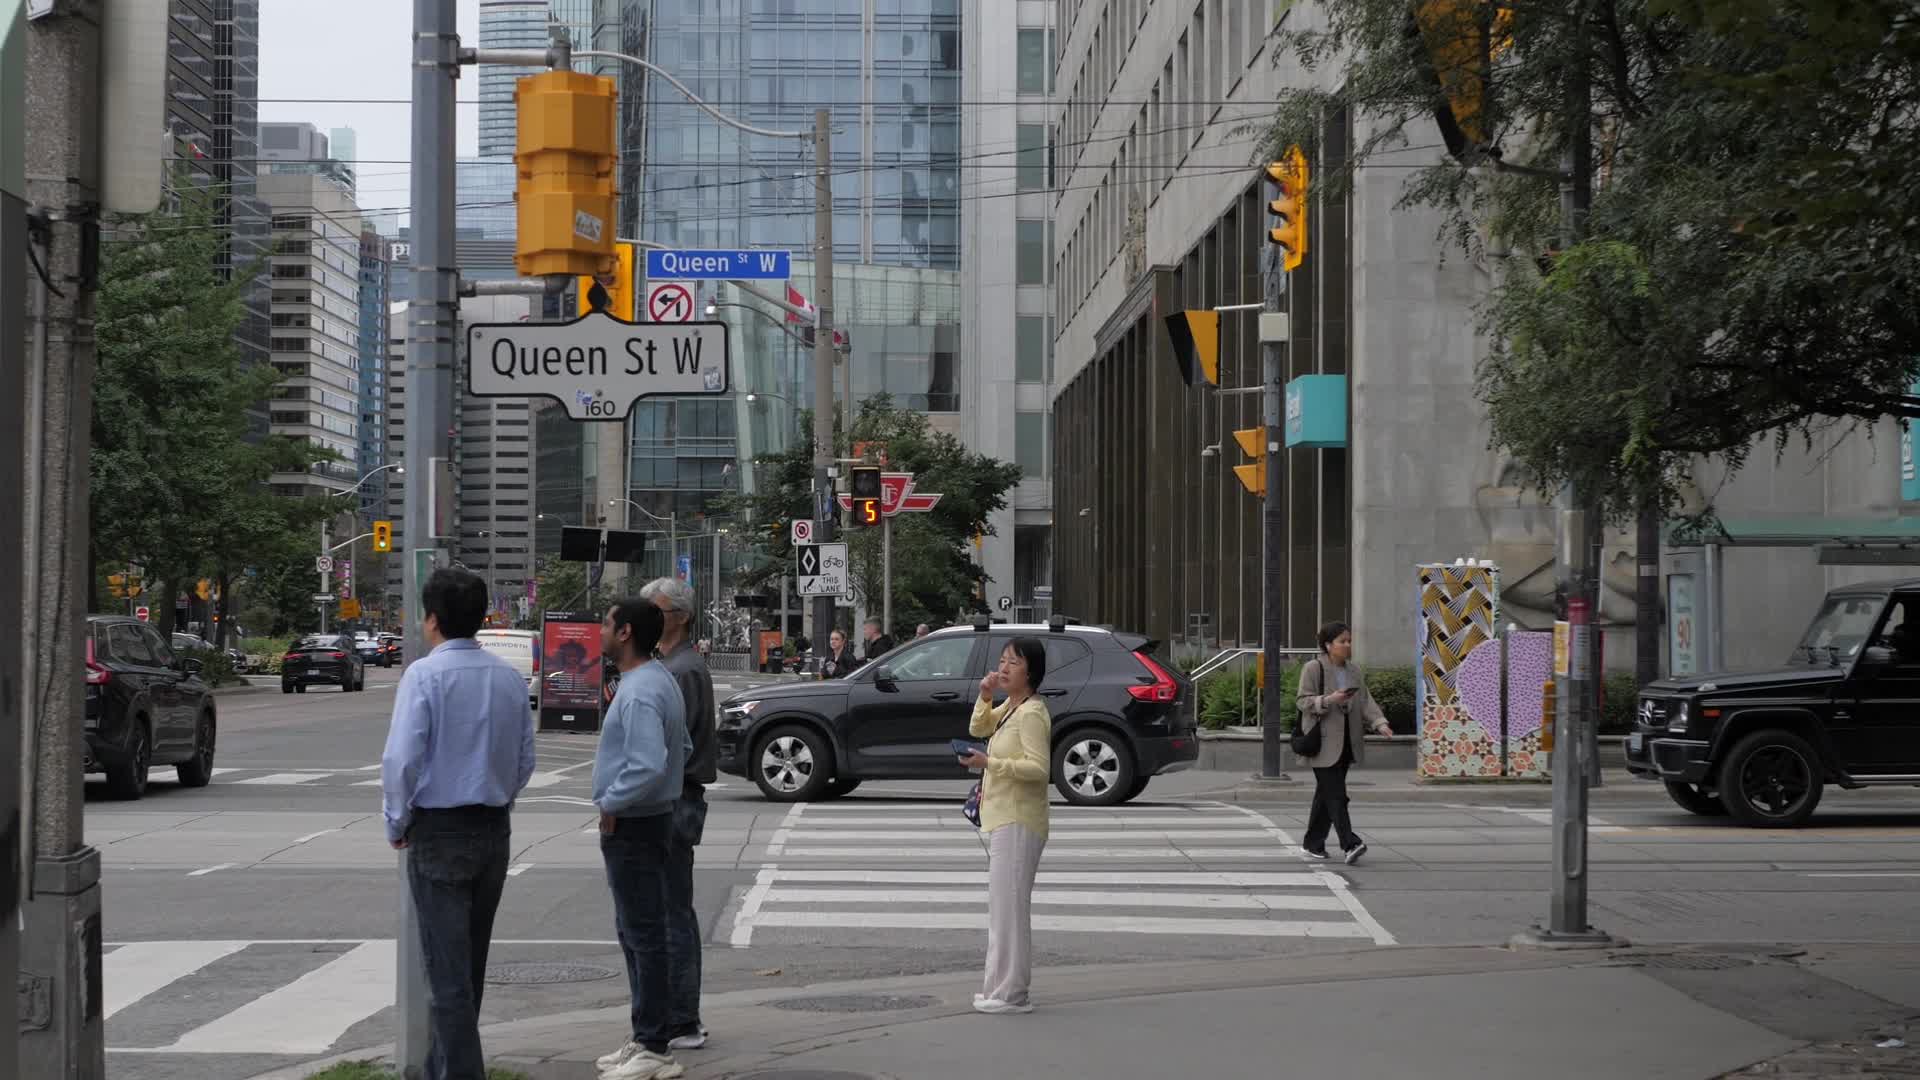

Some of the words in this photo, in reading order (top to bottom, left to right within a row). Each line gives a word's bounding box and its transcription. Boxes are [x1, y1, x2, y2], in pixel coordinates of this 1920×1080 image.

[662, 252, 729, 273] Queen
[737, 253, 748, 264] St
[759, 253, 776, 273] W
[491, 337, 607, 380] Queen
[624, 337, 658, 375] St
[673, 337, 702, 375] W
[865, 500, 876, 522] 5
[820, 585, 841, 593] LANE
[822, 576, 839, 584] THIS
